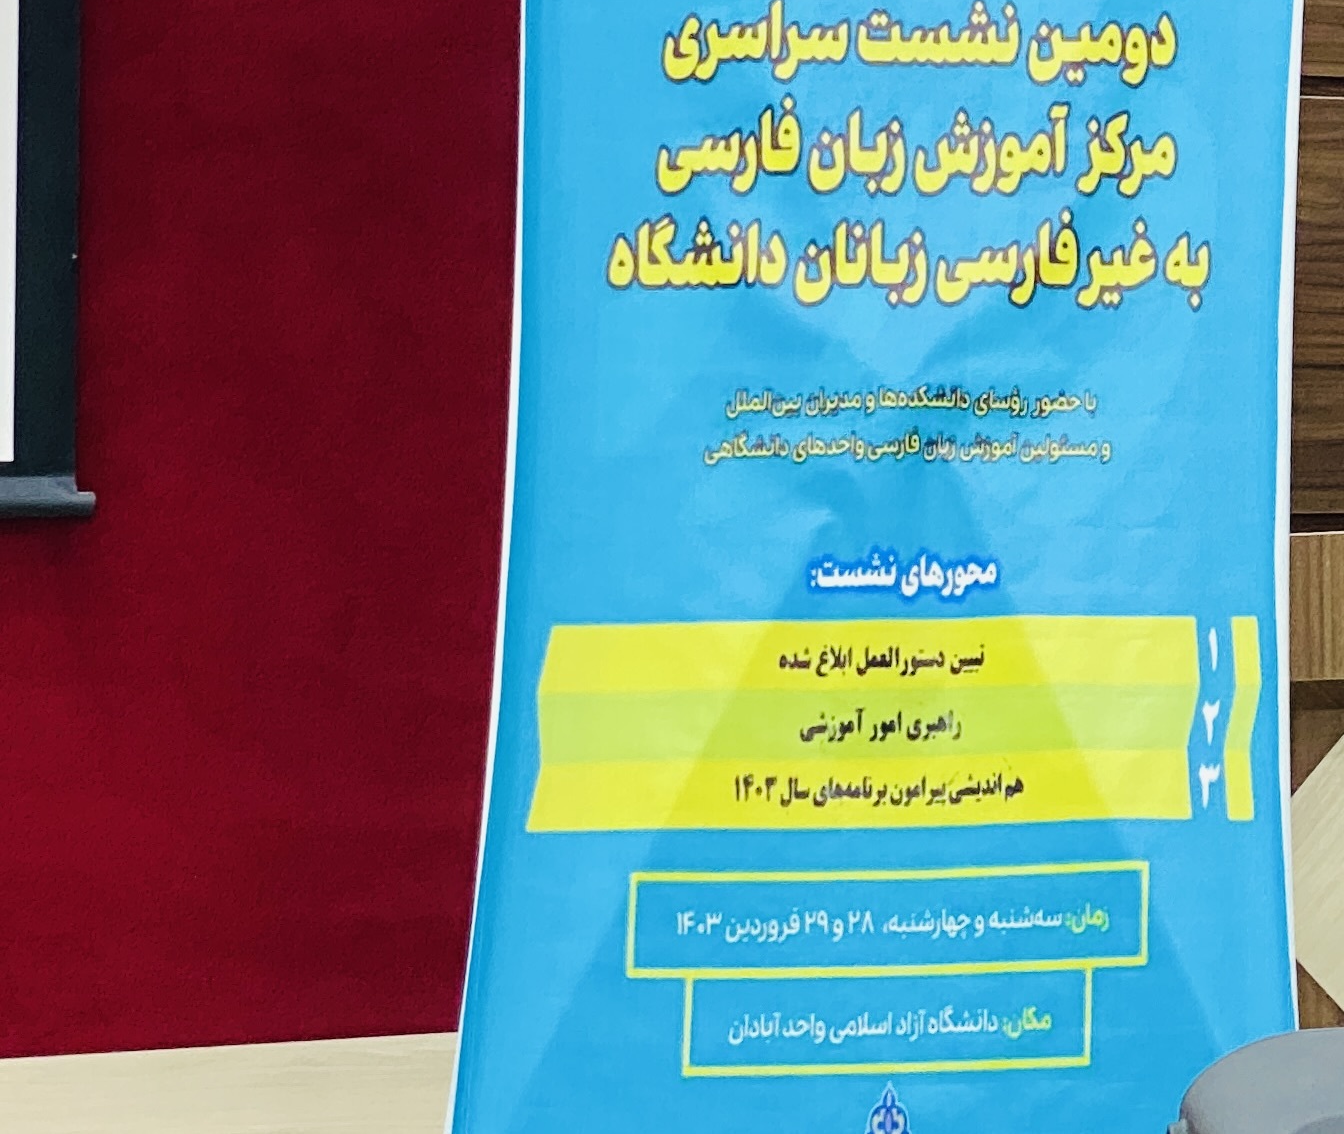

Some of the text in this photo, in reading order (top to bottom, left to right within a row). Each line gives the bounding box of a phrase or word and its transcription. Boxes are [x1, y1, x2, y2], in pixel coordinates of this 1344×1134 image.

[1027, 10, 1177, 88] دومین
[656, 92, 1178, 198] مرکز آموزش زبان فارسی
[607, 213, 789, 289] دانشگاه
[793, 218, 930, 308] زبانان
[1163, 231, 1212, 312] به
[805, 386, 863, 417] مدیران
[864, 392, 876, 414] و
[1031, 389, 1082, 417] حضور
[1083, 387, 1098, 418] با
[703, 426, 1111, 466] و مسئولین آموزش زبان فارسی واحدهای دانشگاهی
[810, 552, 998, 598] محورهای نشست:
[779, 647, 812, 670] شده
[815, 644, 853, 677] ابلاغ
[799, 706, 962, 744] راهبری امور آموزشی
[1202, 699, 1220, 746] ۲
[734, 773, 778, 802] ۱۴۰۳
[780, 775, 811, 808] سال
[1198, 763, 1220, 809] ۳
[675, 911, 723, 936] ۱۴۰۳
[724, 907, 801, 944] فروردین
[804, 909, 829, 934] ۲۹
[831, 917, 844, 943] و
[847, 909, 875, 934] ۲۸
[973, 913, 985, 938] و
[1064, 902, 1110, 935] زمان:
[727, 1005, 1053, 1046] مکان: دانشگاه آزاد اسلامی واحد آبادان
